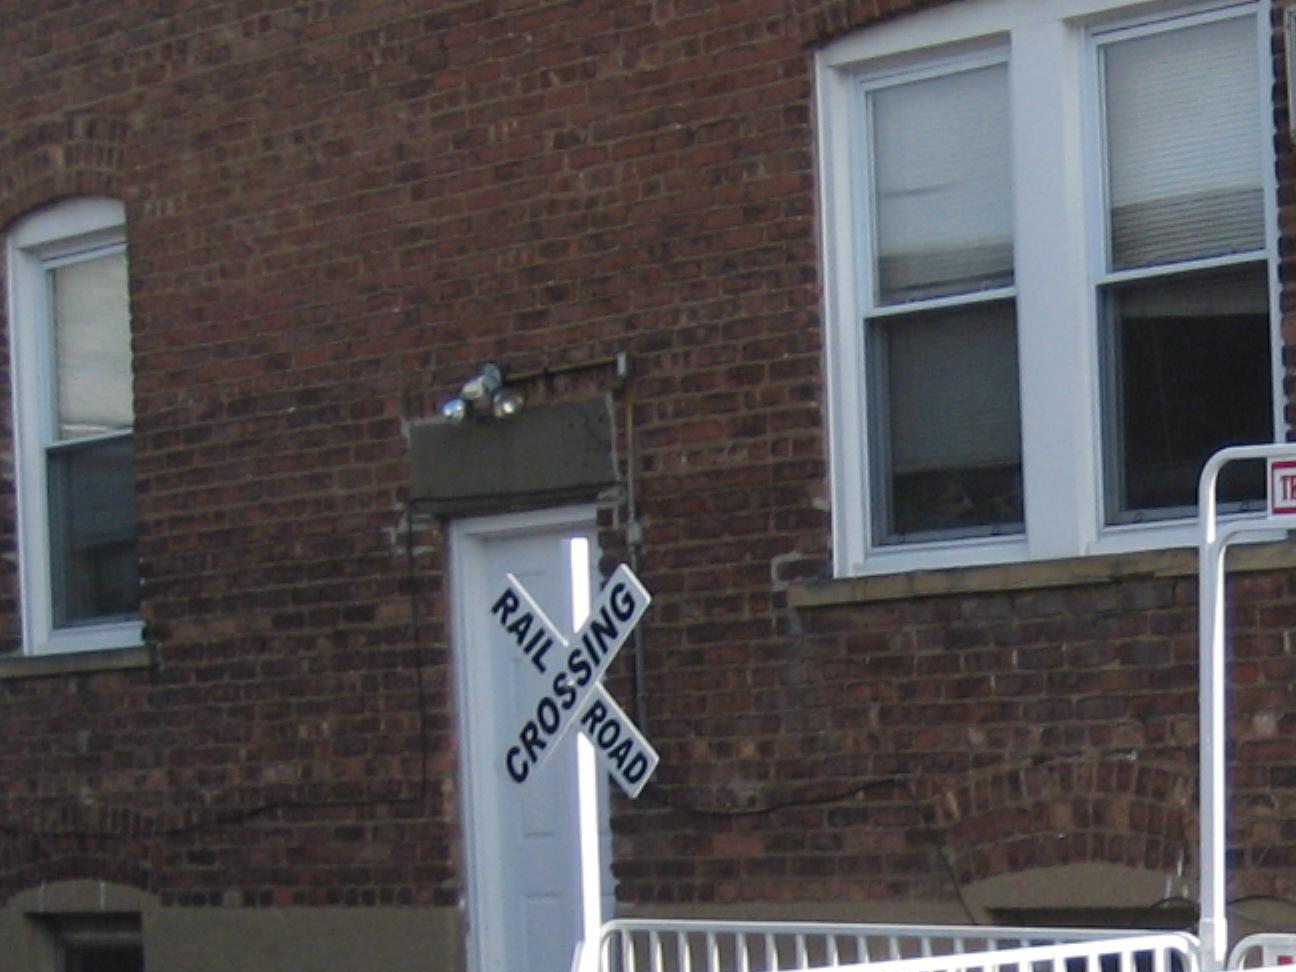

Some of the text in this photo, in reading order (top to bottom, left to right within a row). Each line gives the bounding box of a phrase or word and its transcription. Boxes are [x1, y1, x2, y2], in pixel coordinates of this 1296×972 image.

[491, 588, 554, 674] RAIL
[506, 582, 635, 784] CROSSING
[580, 700, 648, 784] ROAD
